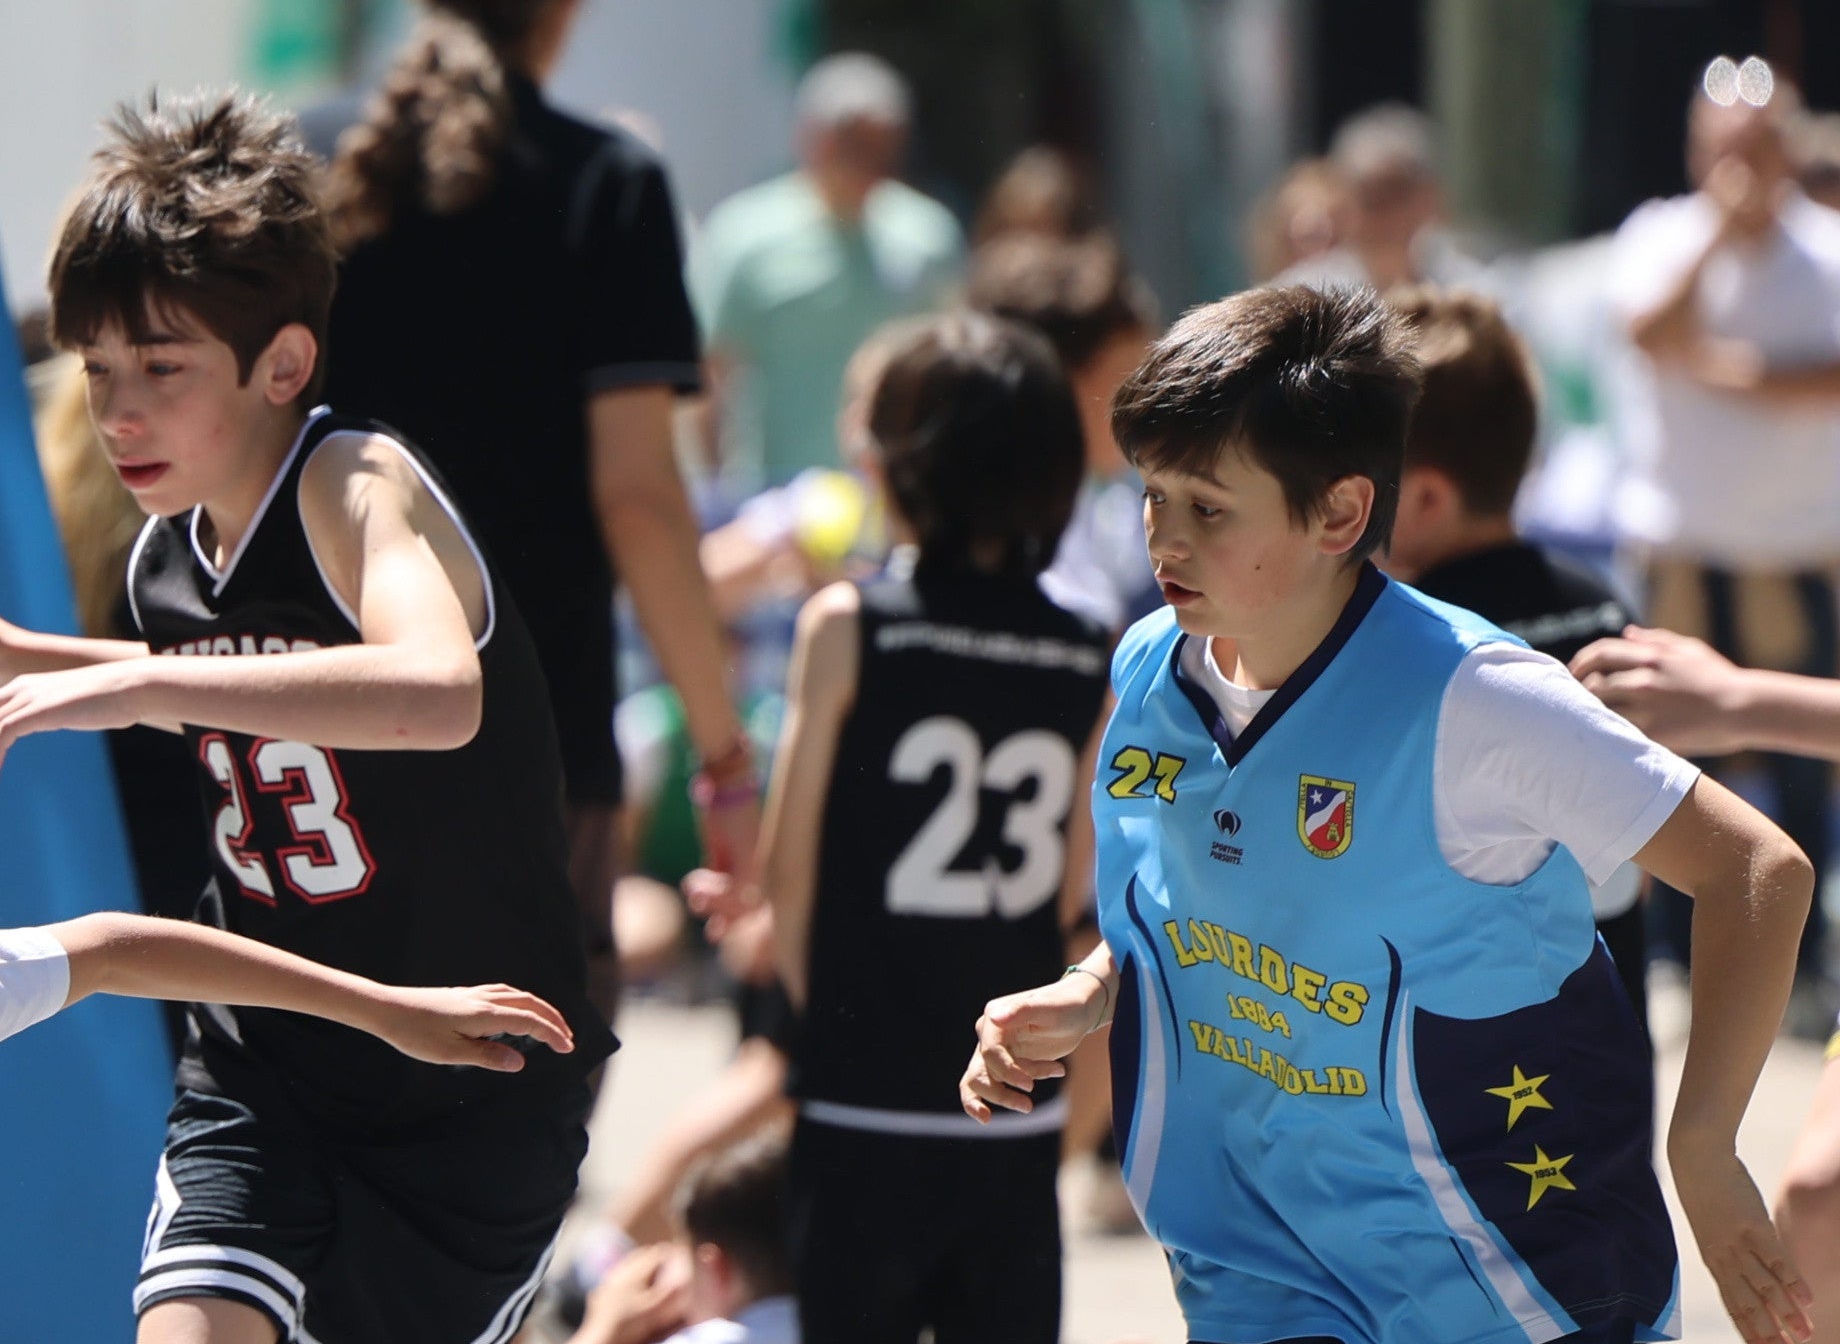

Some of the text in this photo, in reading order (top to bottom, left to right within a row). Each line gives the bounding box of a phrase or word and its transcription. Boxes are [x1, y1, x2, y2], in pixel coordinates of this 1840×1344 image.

[1106, 745, 1187, 805] 27
[884, 715, 1077, 919] 23
[1163, 917, 1370, 1027] LOURDES
[1227, 993, 1292, 1039] 1884
[1188, 1020, 1368, 1097] VALLADOLID
